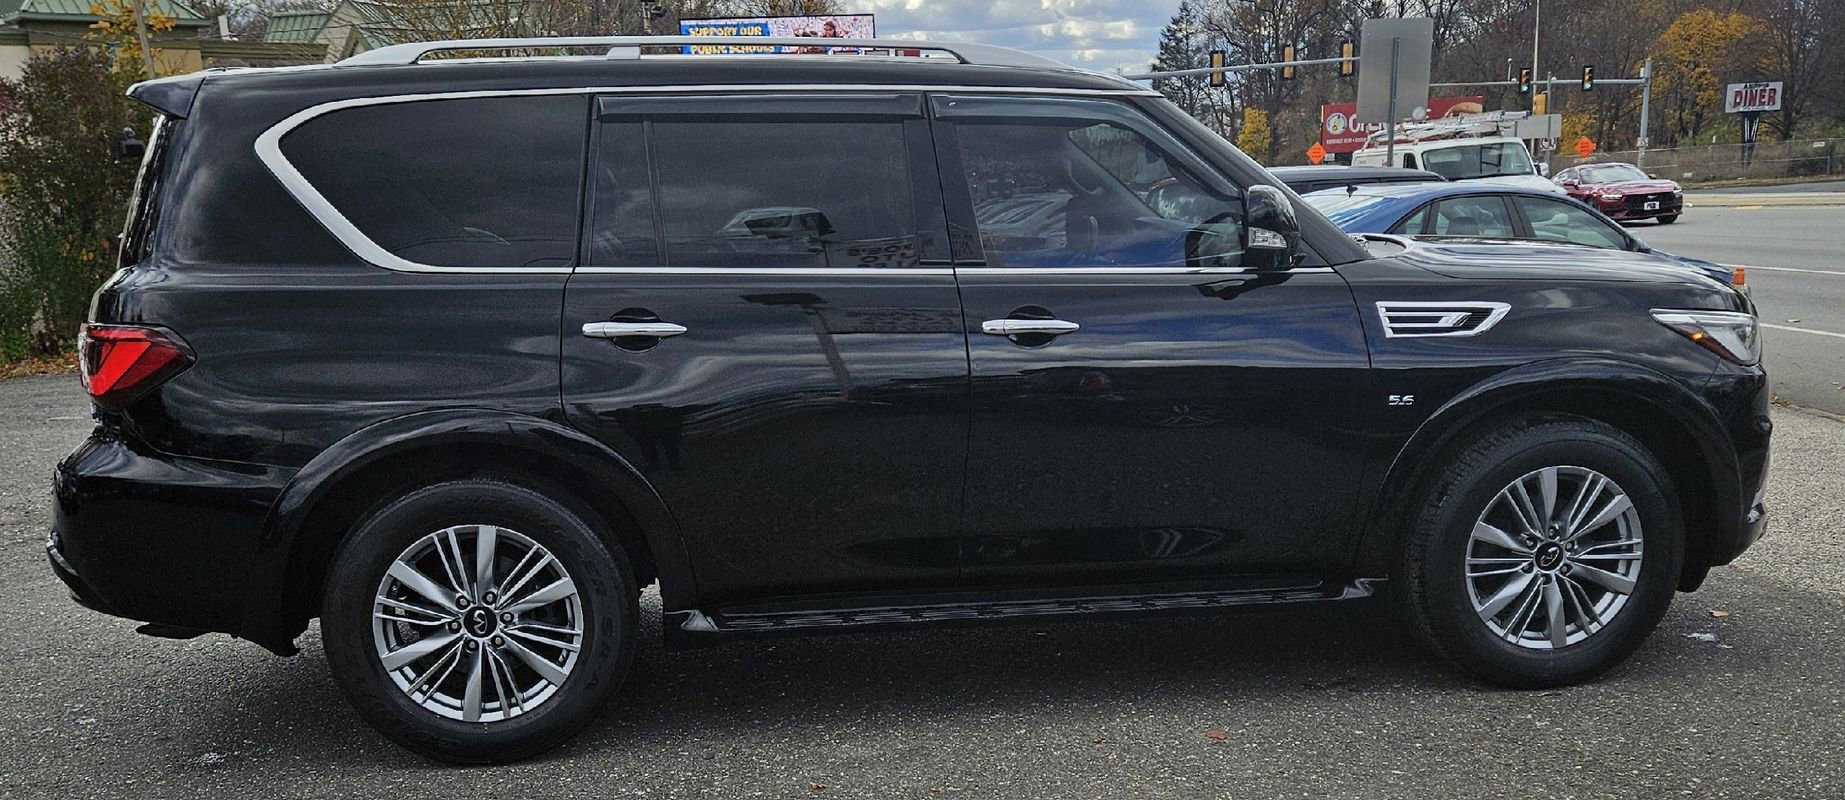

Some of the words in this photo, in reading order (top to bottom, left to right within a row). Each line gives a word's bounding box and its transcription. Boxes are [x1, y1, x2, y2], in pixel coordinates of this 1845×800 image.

[688, 26, 737, 36] SUPPORT
[740, 25, 762, 35] OUR
[691, 45, 727, 54] PUBLIC
[729, 45, 774, 53] SCHOOLS
[1733, 88, 1777, 108] DINER
